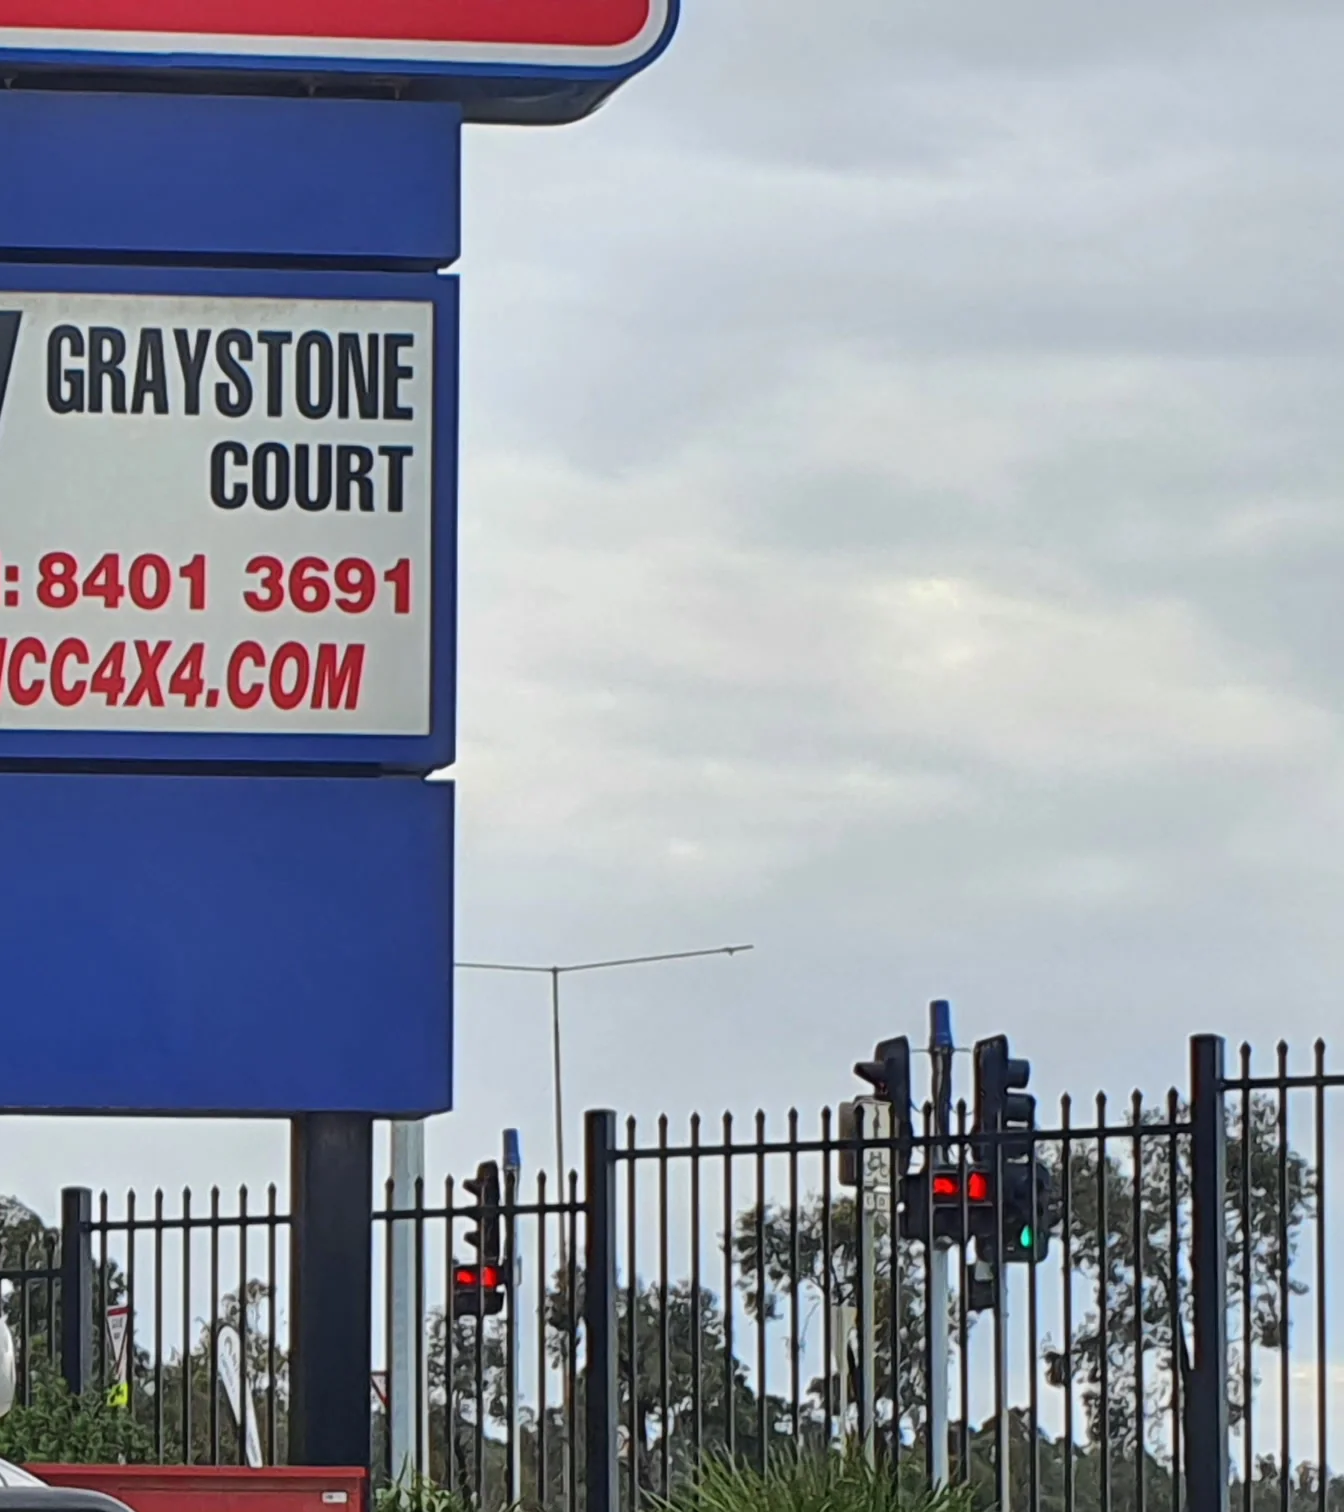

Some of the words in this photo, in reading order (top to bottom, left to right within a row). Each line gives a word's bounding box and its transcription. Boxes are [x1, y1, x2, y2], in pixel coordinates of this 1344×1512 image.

[46, 325, 414, 420] GRAYSTONE
[210, 441, 414, 512] COURT
[37, 552, 206, 610] 8401
[244, 556, 411, 614] 3691
